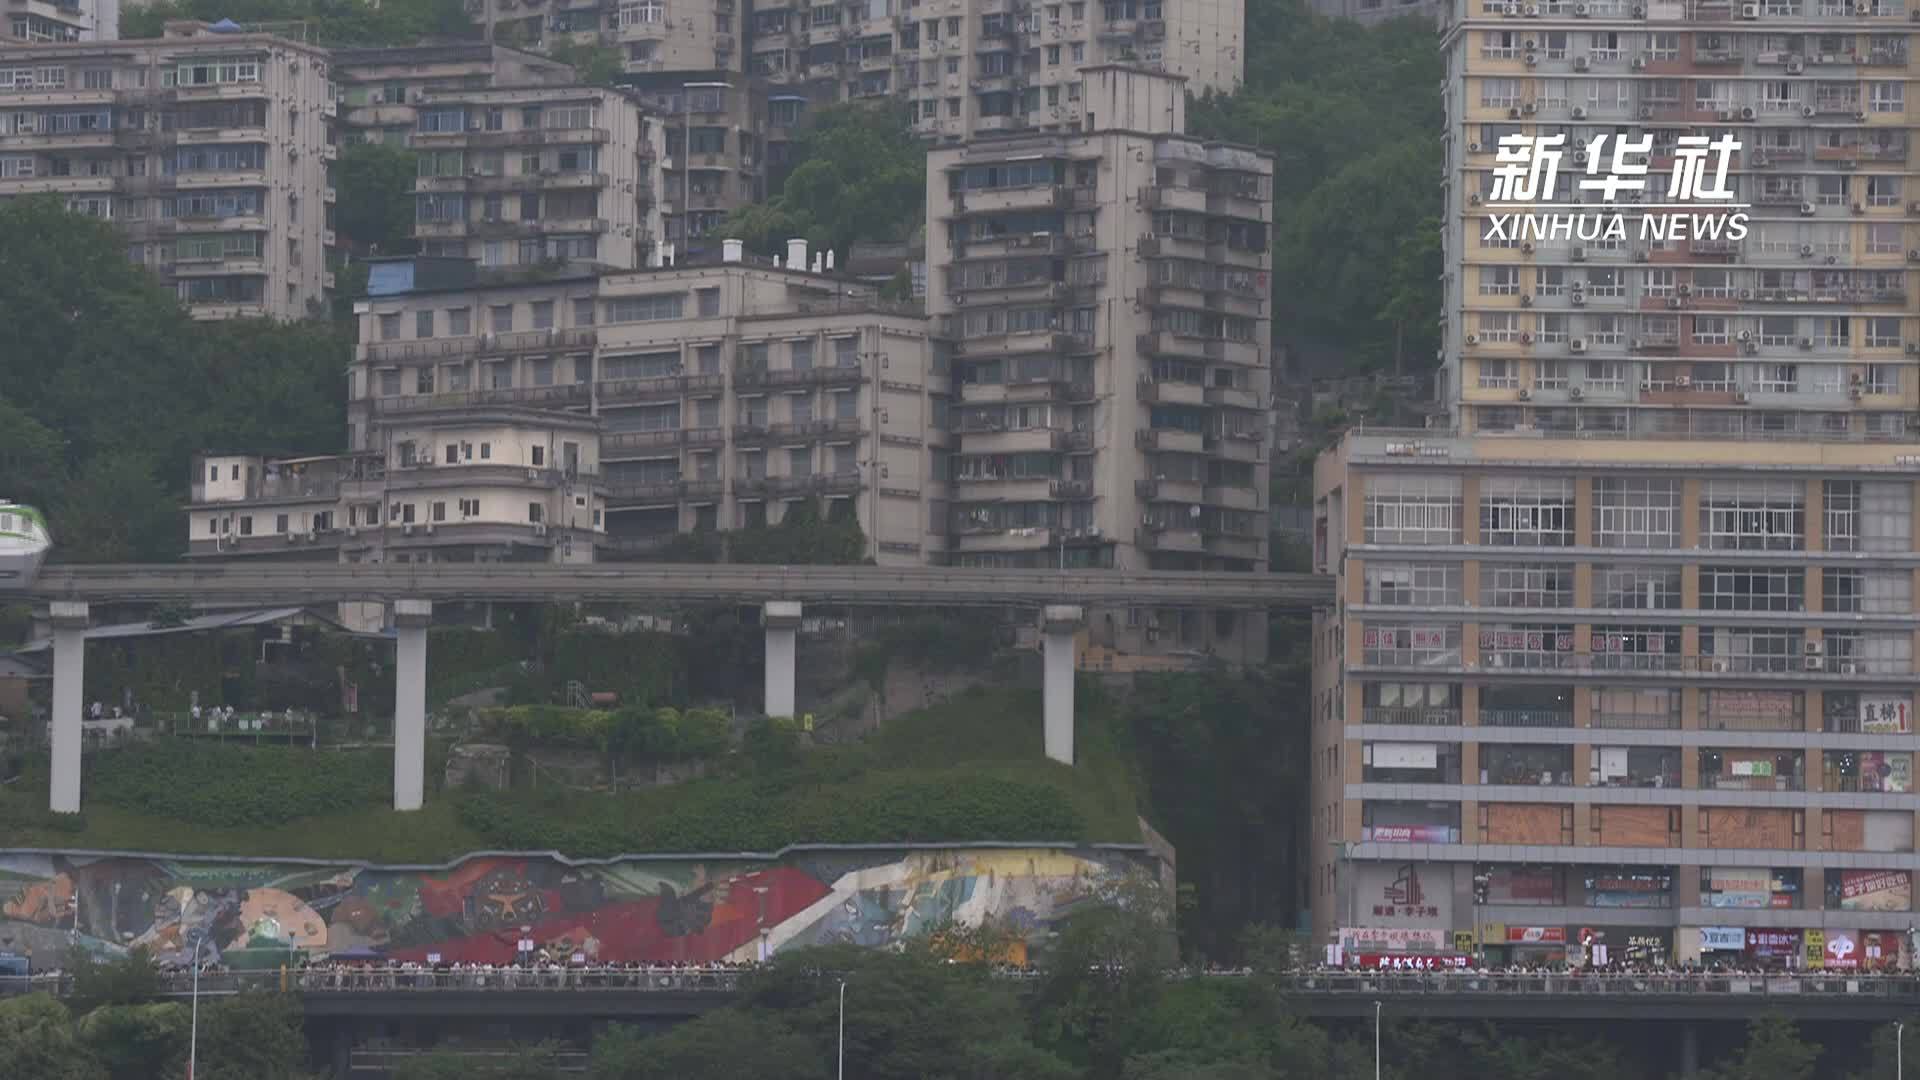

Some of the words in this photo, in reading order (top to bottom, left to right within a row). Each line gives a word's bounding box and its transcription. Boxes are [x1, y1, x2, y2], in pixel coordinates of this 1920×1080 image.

[1864, 701, 1896, 722] 直梯
[1758, 933, 1795, 945] 蜜雪冰
